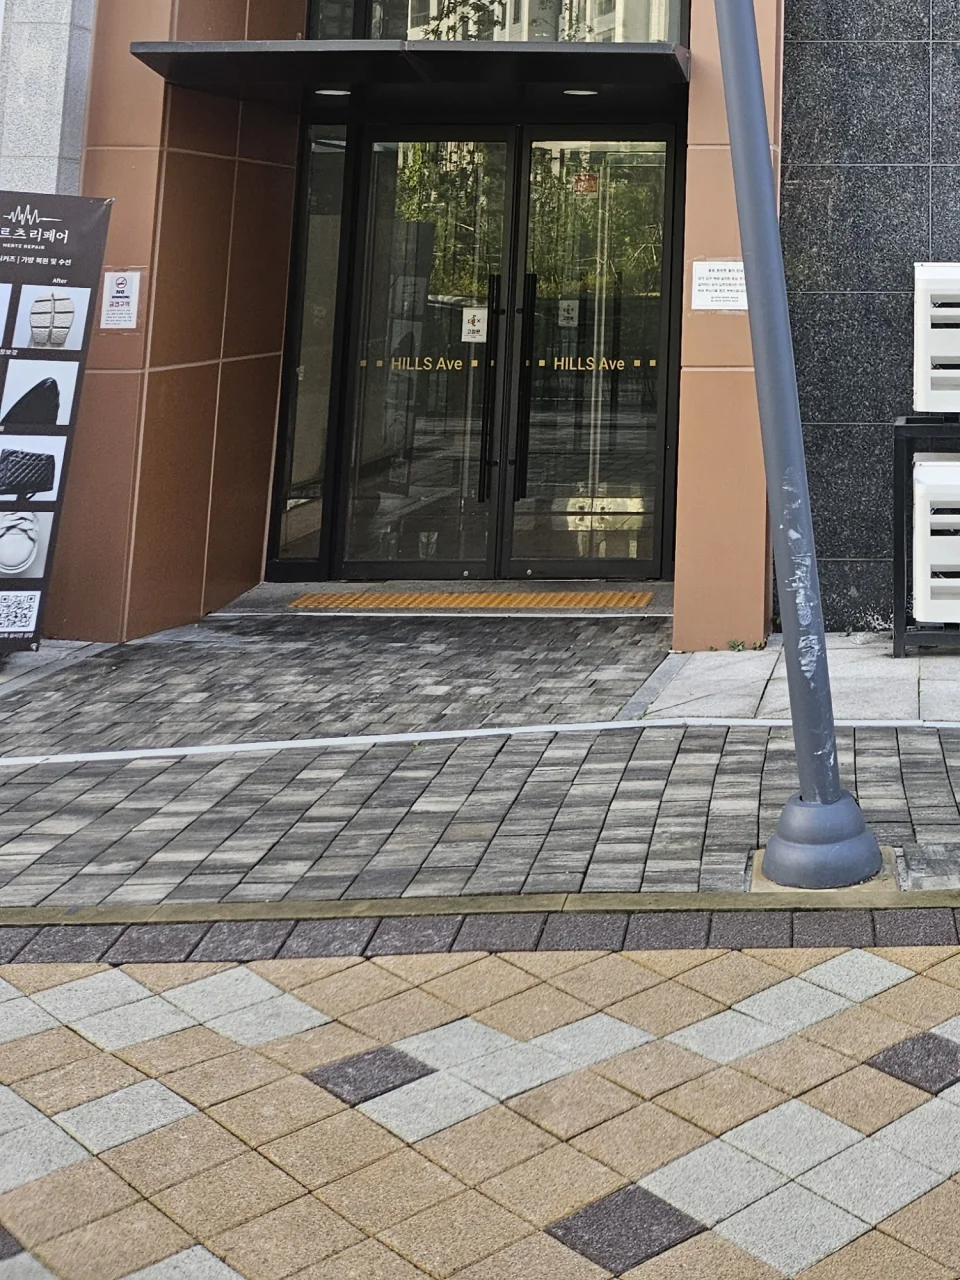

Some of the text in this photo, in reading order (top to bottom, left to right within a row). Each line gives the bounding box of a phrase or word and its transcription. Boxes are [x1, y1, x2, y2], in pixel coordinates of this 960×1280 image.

[29, 228, 69, 244] 리페어
[21, 256, 35, 264] 가방
[391, 357, 463, 370] HILLS Ave
[554, 357, 625, 370] HILLS Ave
